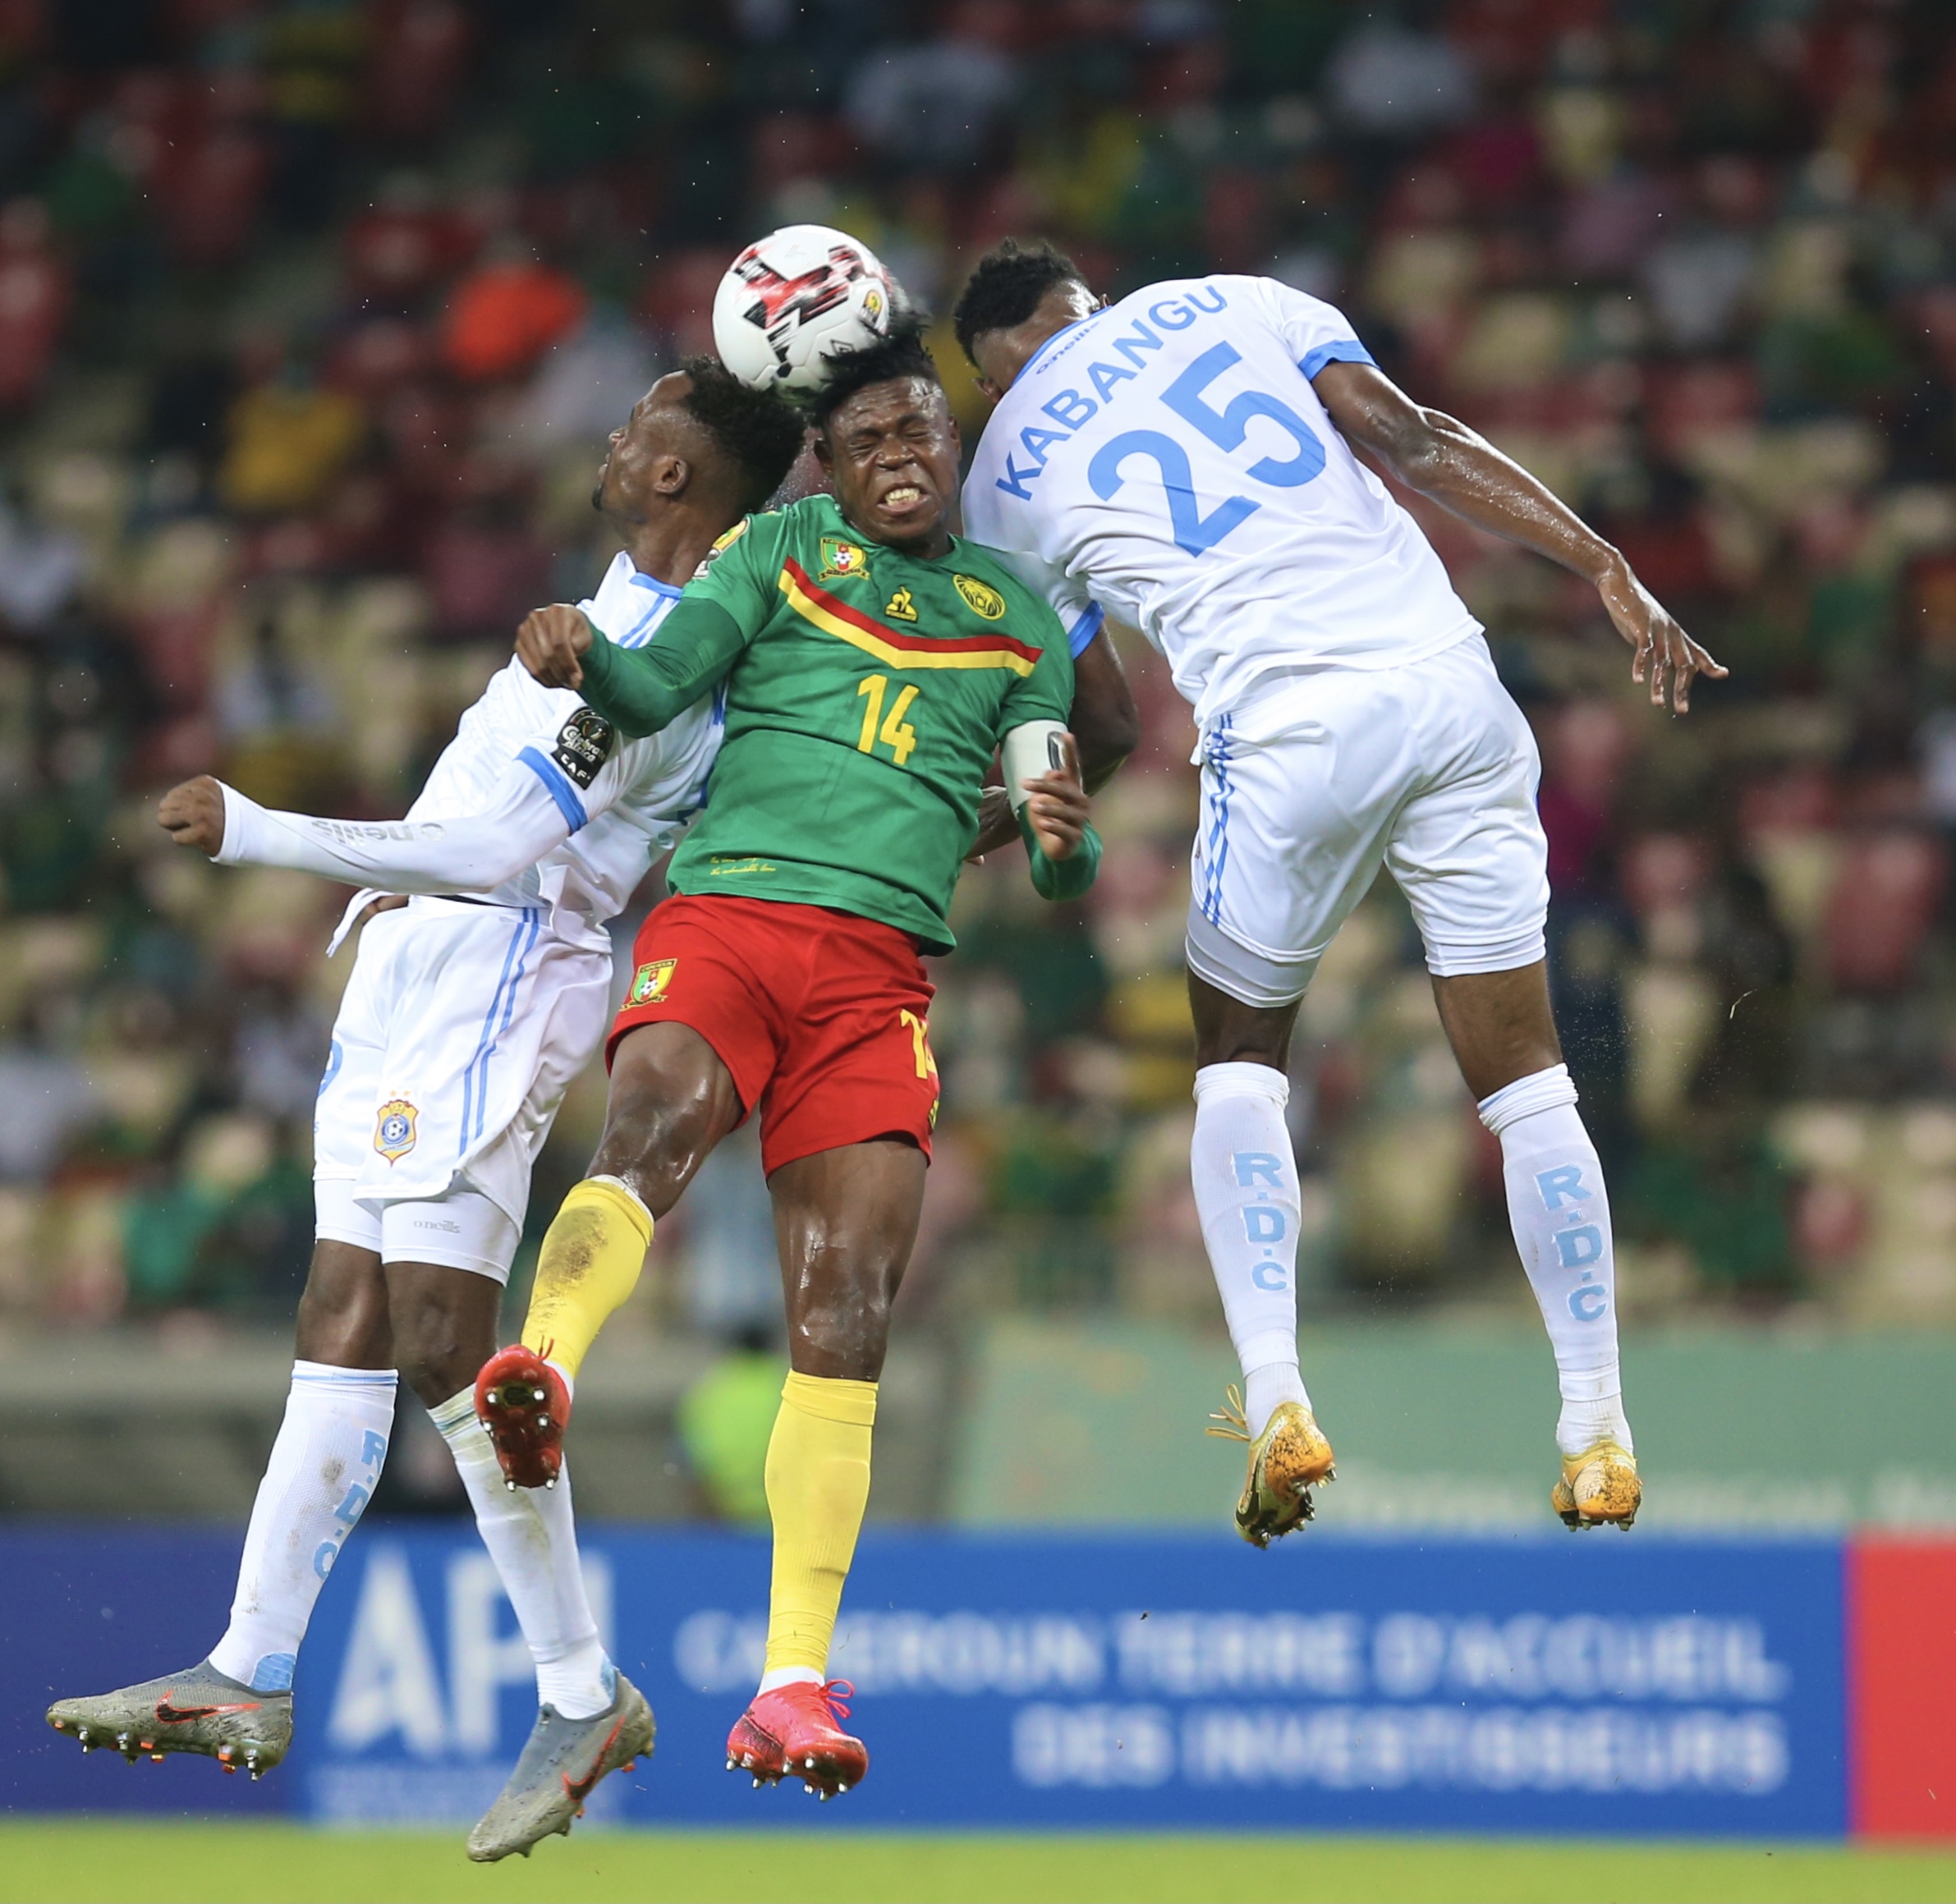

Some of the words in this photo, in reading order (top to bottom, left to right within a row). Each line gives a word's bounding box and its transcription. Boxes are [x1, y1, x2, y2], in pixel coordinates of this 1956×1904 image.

[994, 284, 1229, 502] KABANGU
[1086, 340, 1327, 559] 25
[560, 753, 588, 778] CAF
[856, 673, 920, 766] 14
[675, 1611, 1104, 1695] CAEROUN
[1117, 1611, 1363, 1697] TERRE
[1012, 1702, 1174, 1788] DES
[1181, 1703, 1791, 1795] INVESTISSEURS
